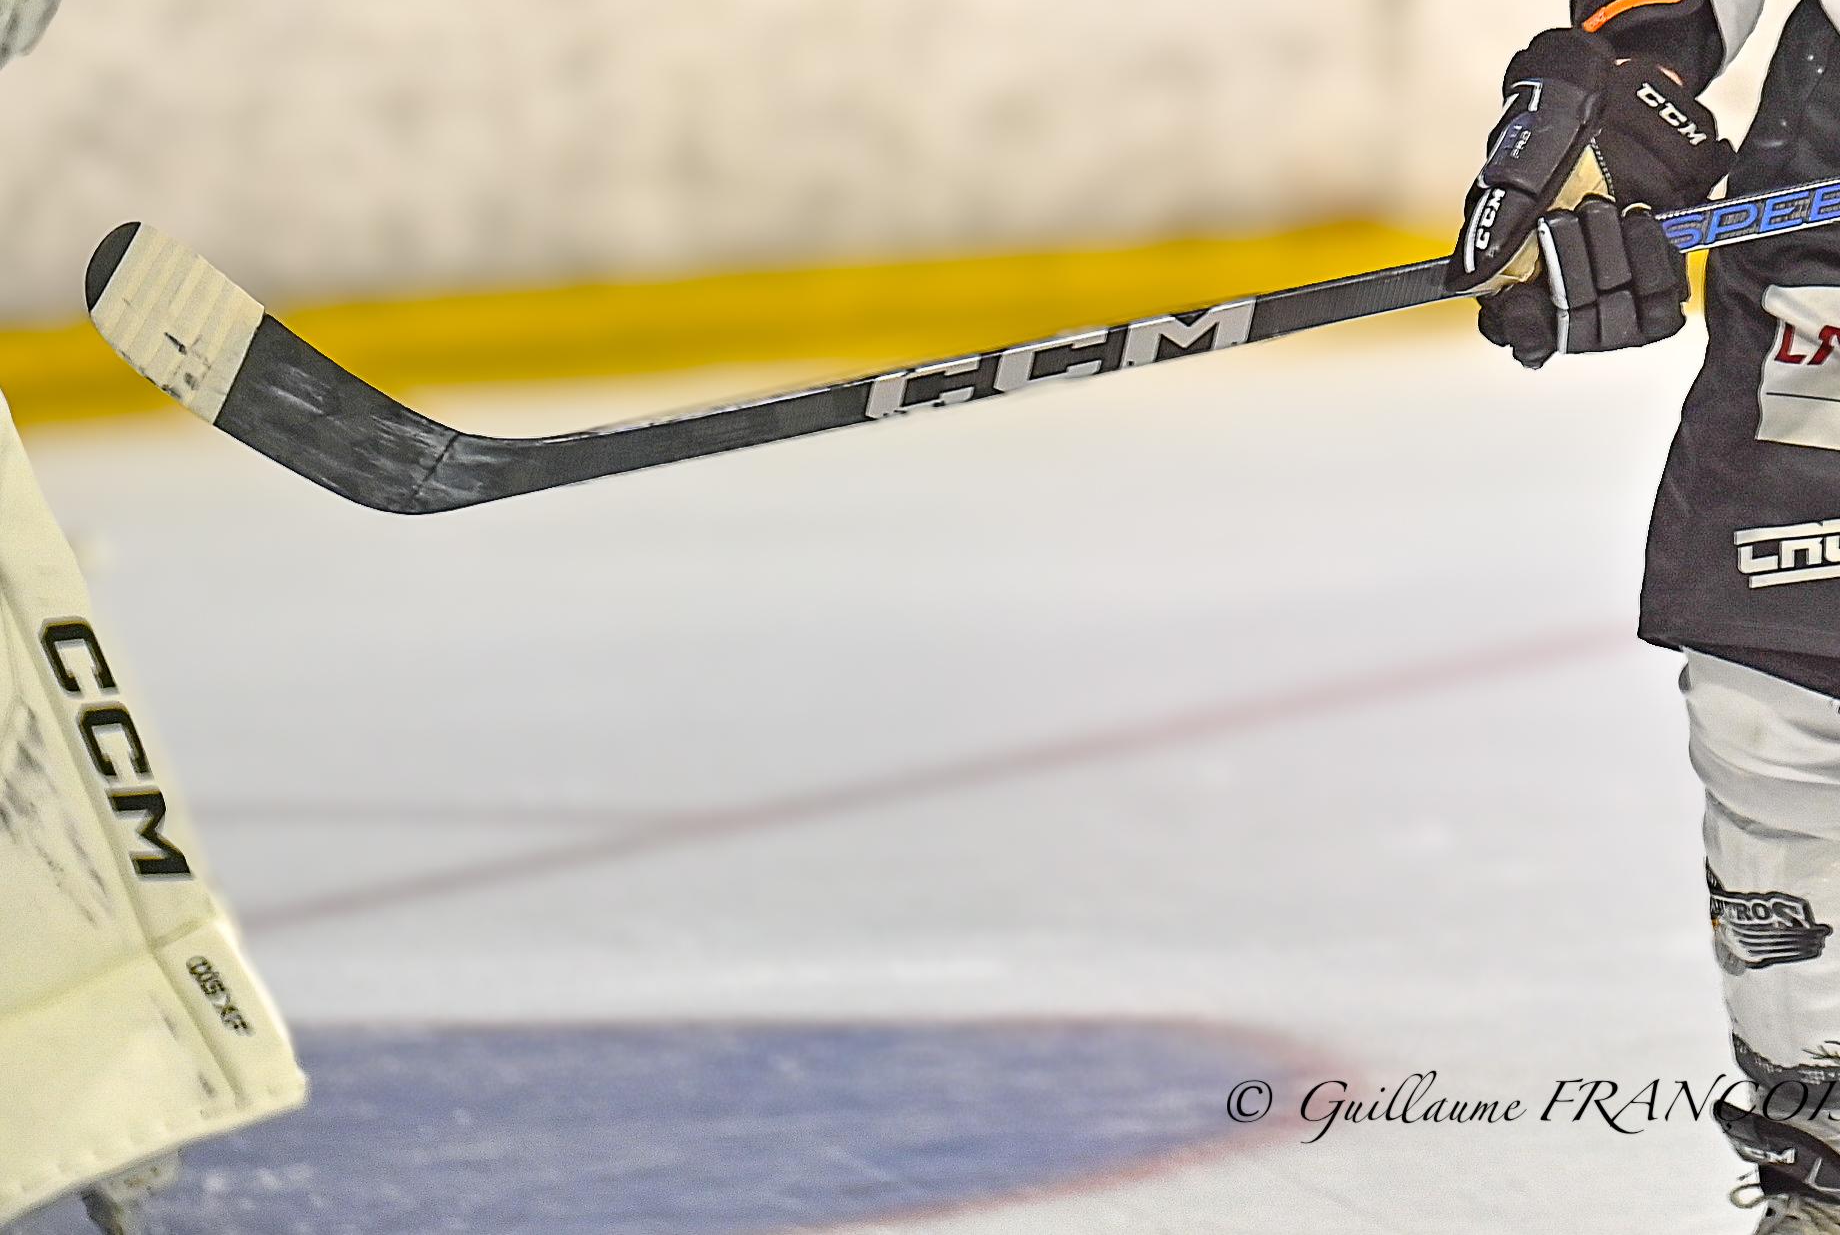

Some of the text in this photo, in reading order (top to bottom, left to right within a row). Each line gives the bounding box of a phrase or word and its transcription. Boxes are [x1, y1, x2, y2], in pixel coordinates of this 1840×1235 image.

[1636, 82, 1707, 146] CCM
[1475, 188, 1506, 250] CCM
[865, 297, 1256, 419] CCM
[39, 616, 194, 879] CCM
